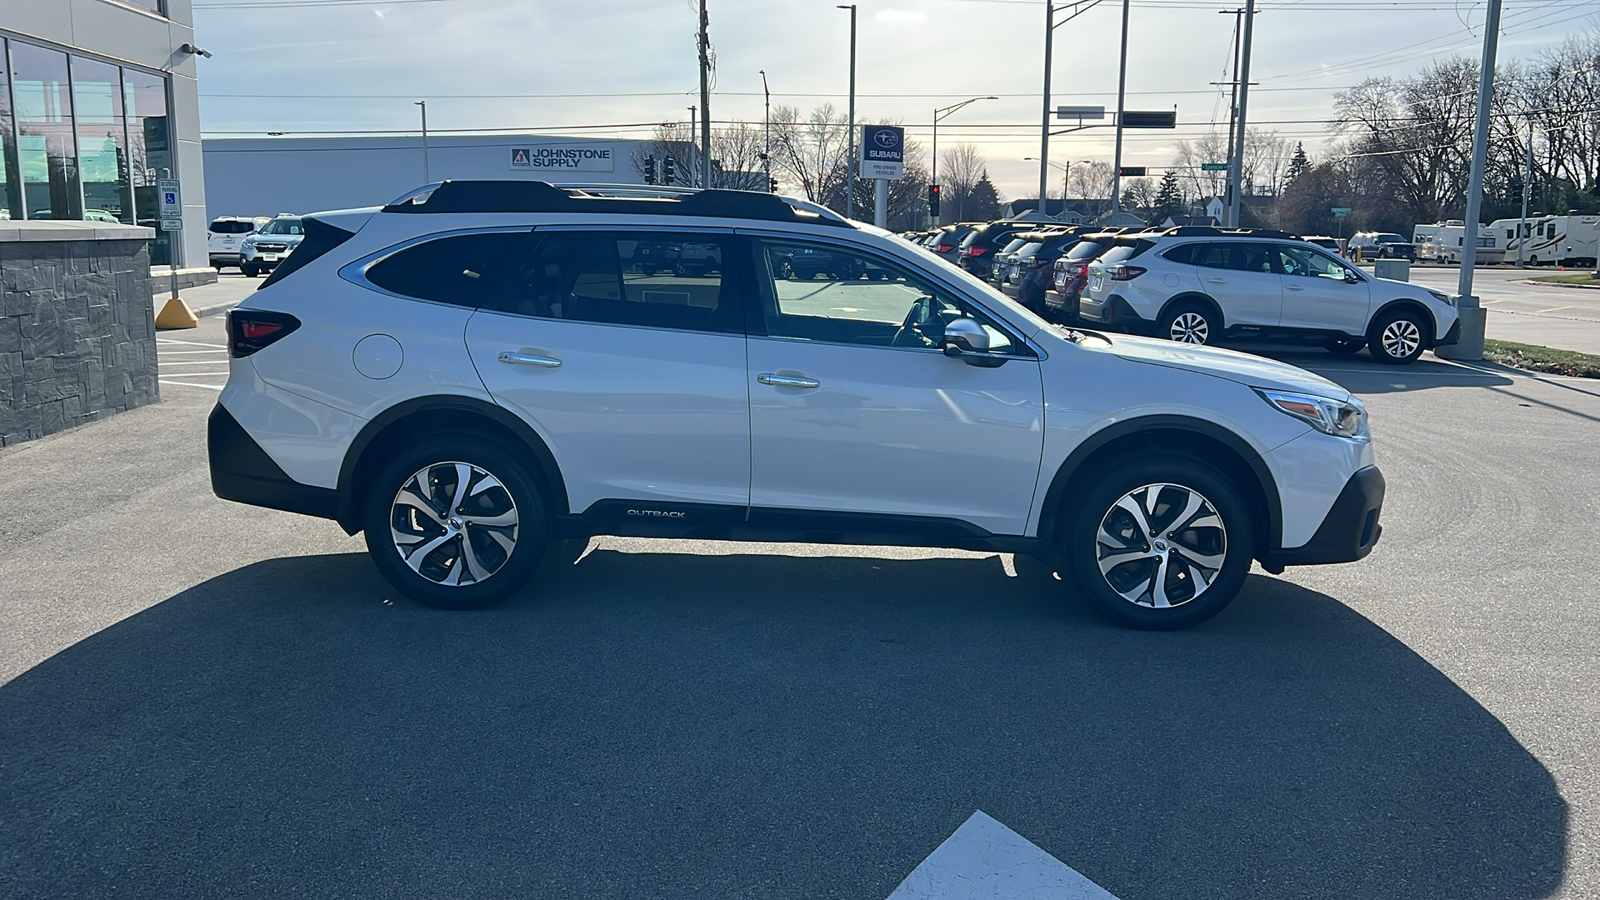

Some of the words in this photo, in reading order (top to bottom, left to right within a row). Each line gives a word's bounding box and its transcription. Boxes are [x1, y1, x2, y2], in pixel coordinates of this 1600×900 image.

[532, 149, 610, 159] JOHNSTONE
[869, 150, 901, 159] SUBARU
[533, 158, 581, 168] SUPPLY
[627, 509, 686, 519] OUTBACK
